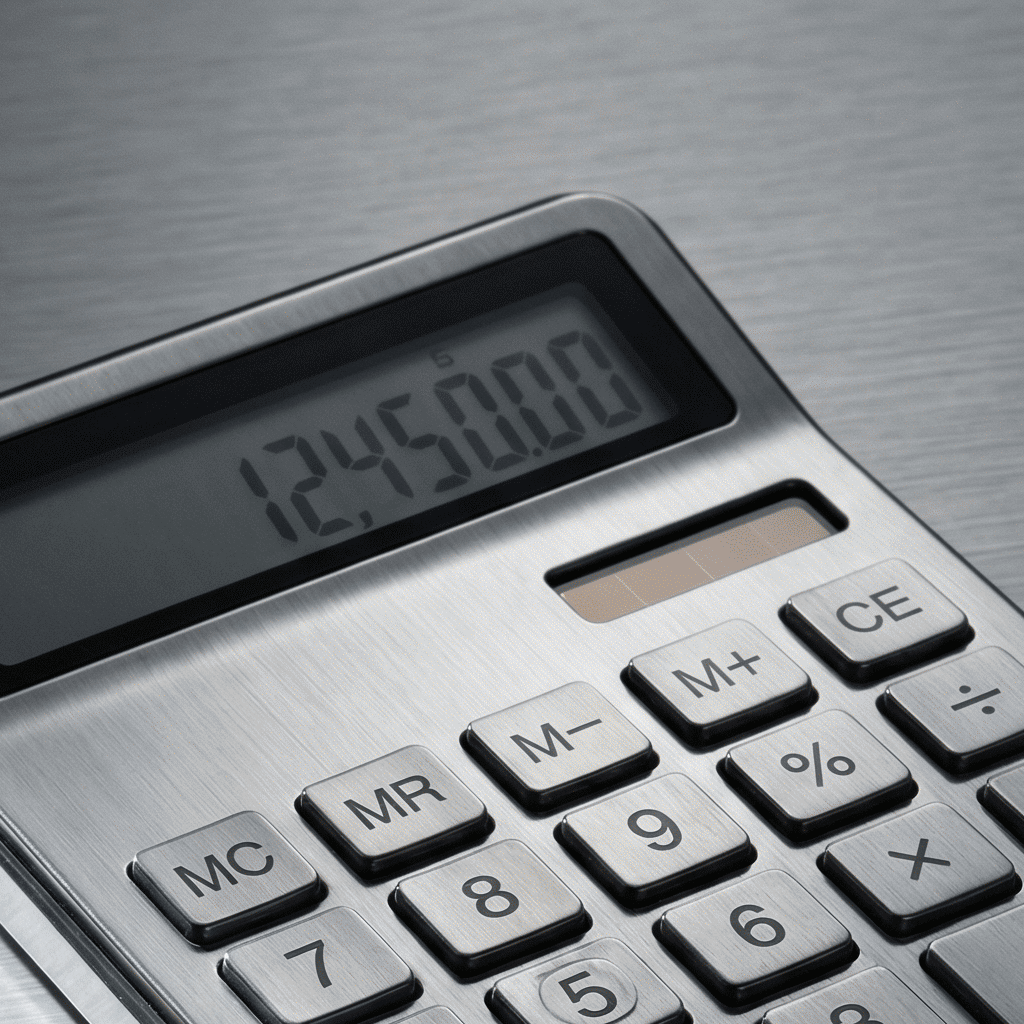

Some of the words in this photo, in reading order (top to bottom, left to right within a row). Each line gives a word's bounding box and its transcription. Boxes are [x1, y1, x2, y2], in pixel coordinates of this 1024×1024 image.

[239, 330, 642, 543] 12,450.00
[836, 586, 922, 632] CE
[671, 650, 761, 699] M+
[781, 742, 856, 787] %
[344, 774, 448, 830] MR
[627, 809, 682, 851] 9
[173, 841, 274, 898] MC
[462, 875, 519, 918] 8
[730, 904, 786, 947] 6
[284, 940, 334, 989] 7
[557, 970, 617, 1018] 5
